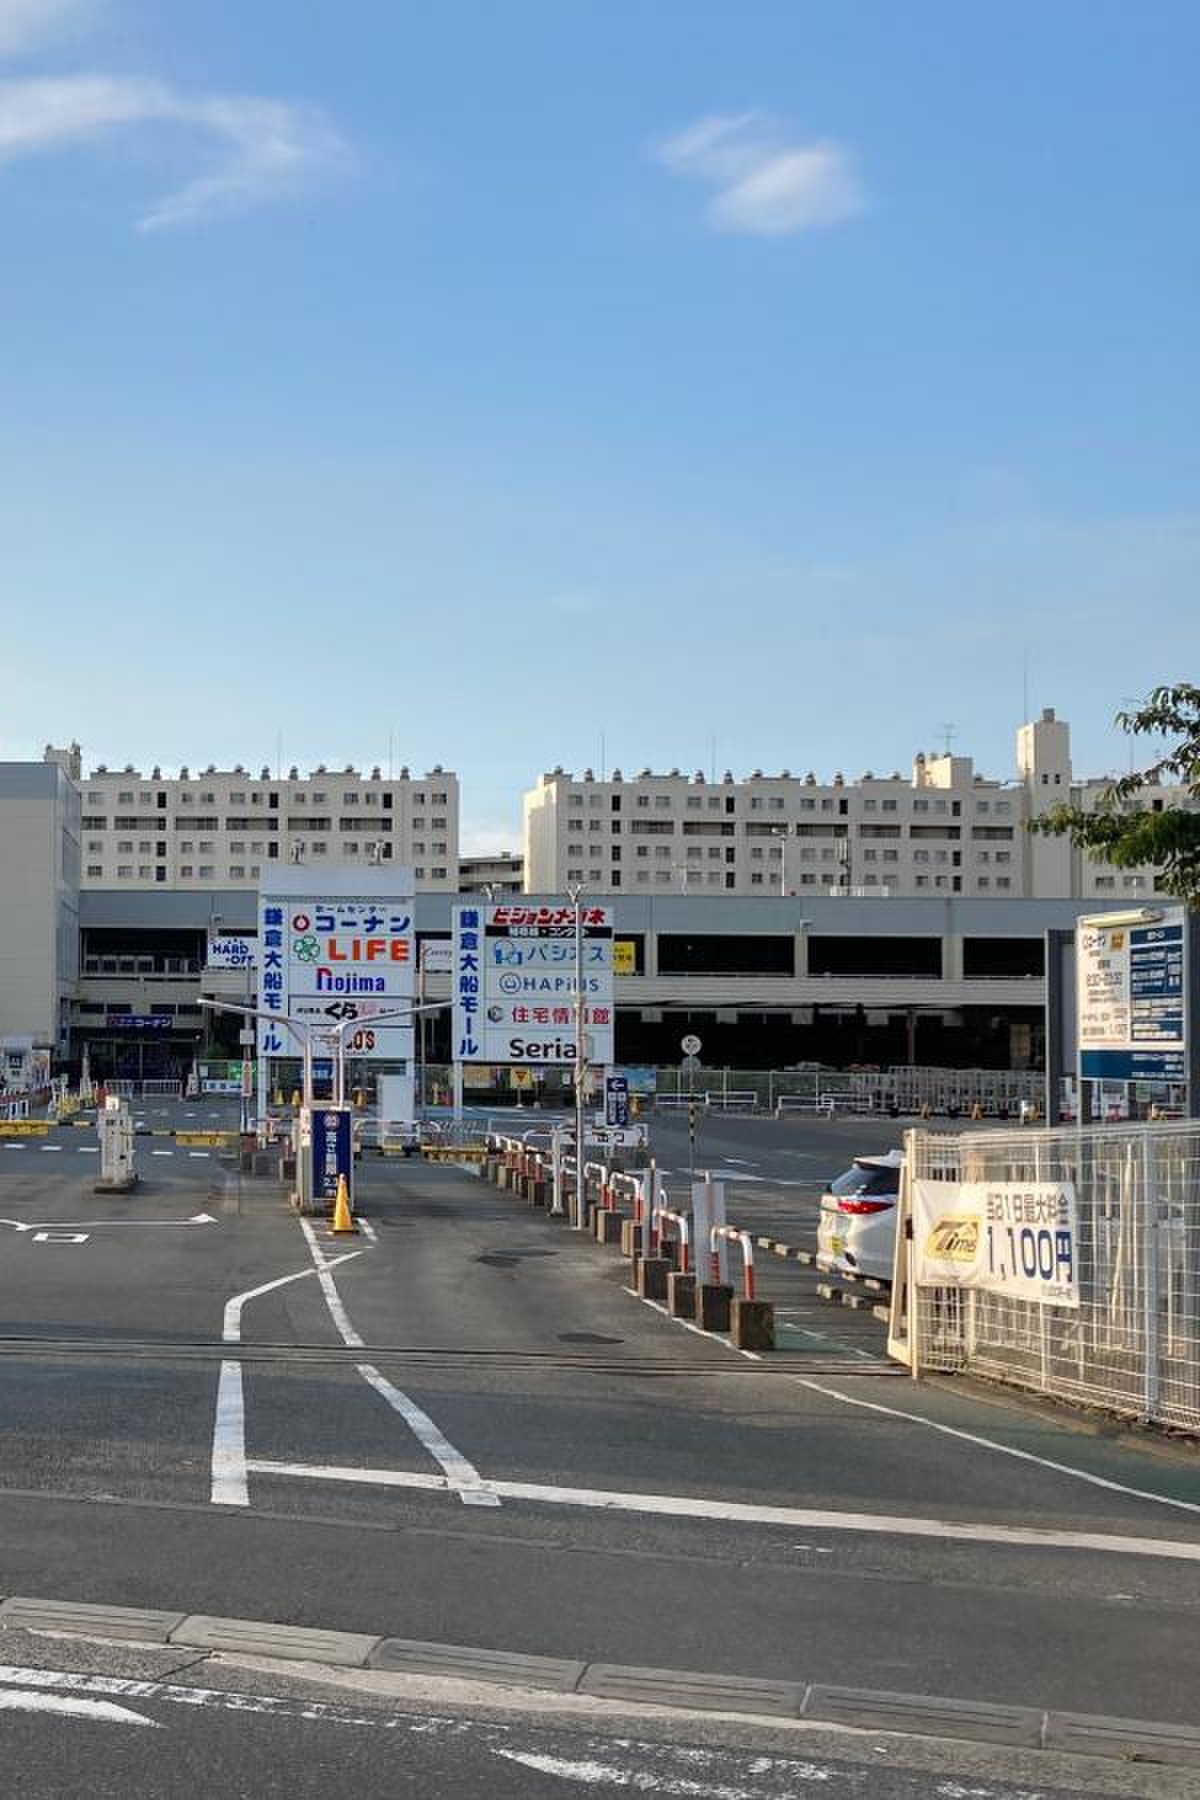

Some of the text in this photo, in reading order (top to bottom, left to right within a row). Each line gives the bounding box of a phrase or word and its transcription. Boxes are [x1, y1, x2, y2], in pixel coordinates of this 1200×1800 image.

[315, 915, 411, 933] コーナン
[327, 938, 410, 962] LIFE
[263, 907, 283, 1052] 鎌倉大船モール
[460, 910, 479, 1056] 鎌倉大船モール
[511, 1006, 610, 1024] 住宅情館
[509, 1038, 578, 1058] Seria
[987, 1225, 1074, 1283] 1,100円
